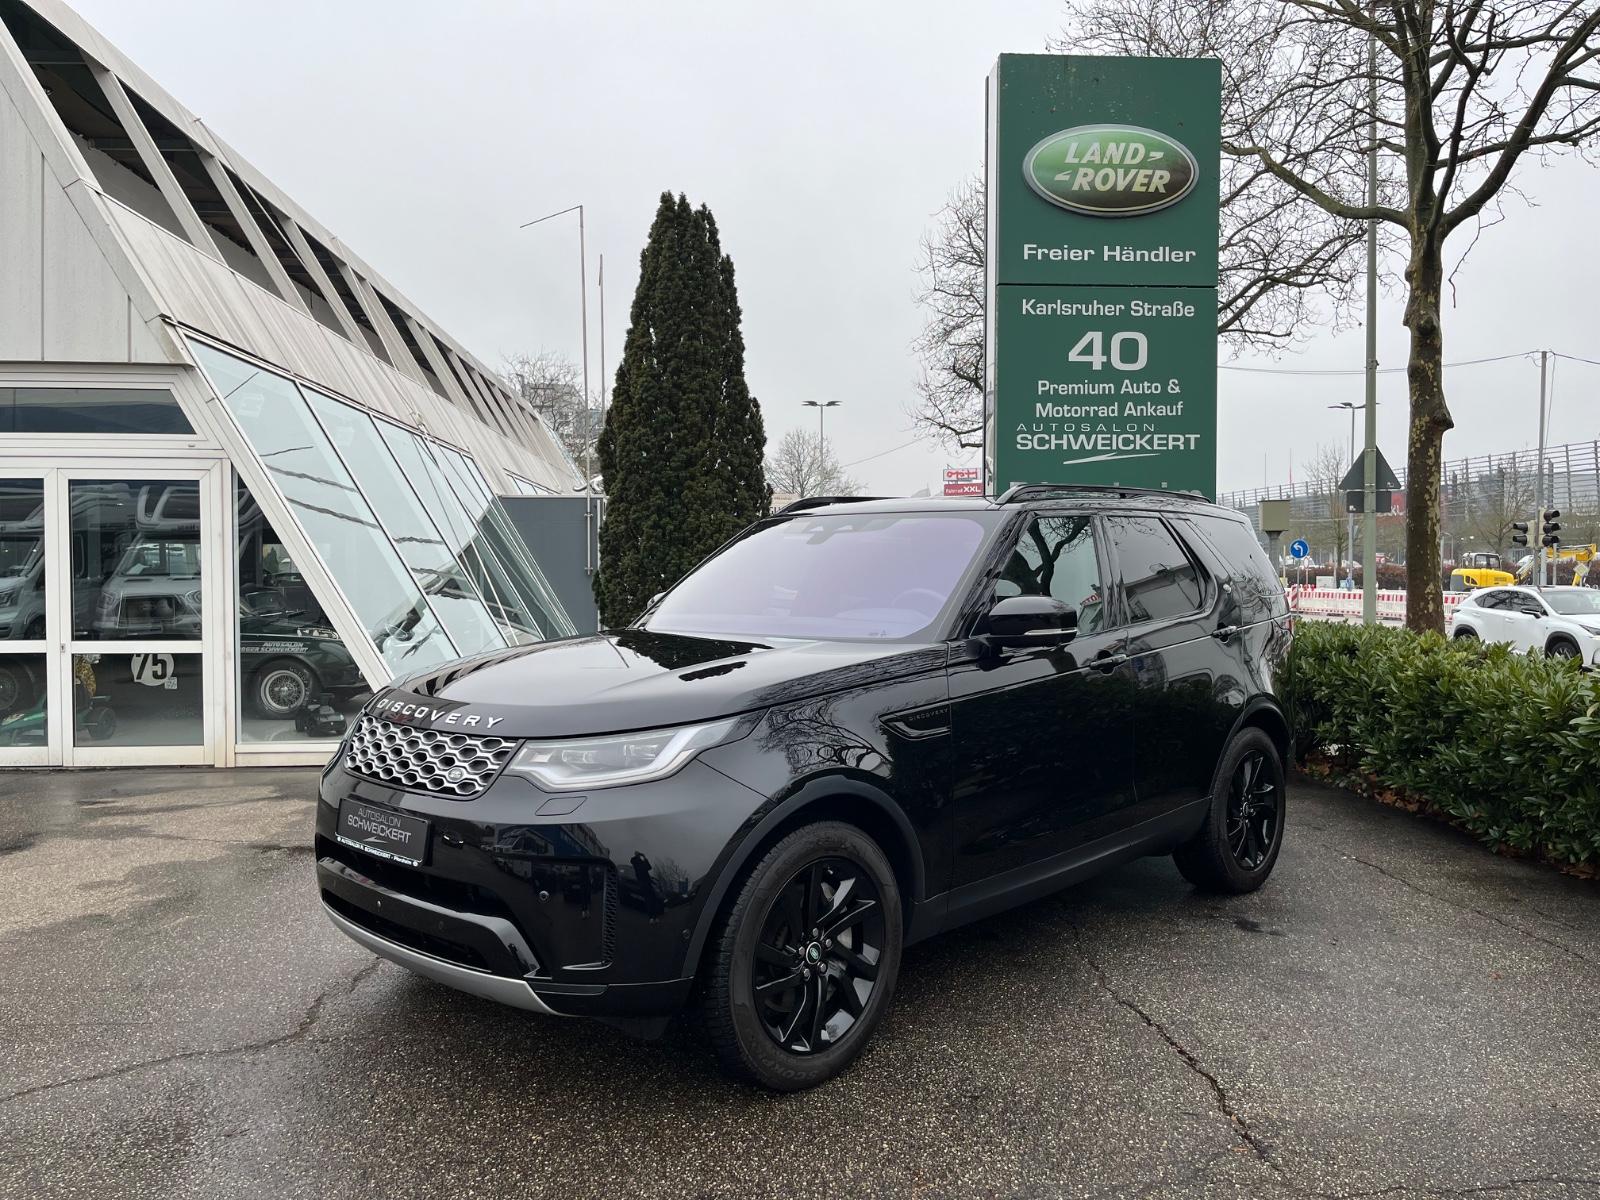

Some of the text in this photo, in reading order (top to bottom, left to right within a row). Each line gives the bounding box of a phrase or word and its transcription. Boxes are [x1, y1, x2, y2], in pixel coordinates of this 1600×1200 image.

[1064, 142, 1146, 165] LAND
[1071, 168, 1171, 193] ROVER
[1023, 244, 1197, 262] Freier Händler
[1022, 299, 1195, 317] Karlsruher Straße
[1068, 331, 1148, 371] 40
[1037, 379, 1181, 395] Premium Auto &
[1035, 401, 1184, 418] Motorrad Ankauf
[1016, 423, 1155, 432] AUTOSALON
[1016, 434, 1201, 450] SCHWEICKERT
[135, 653, 168, 680] 75
[376, 698, 504, 729] DISCOVERY
[358, 808, 401, 827] AUTOSALON
[347, 814, 412, 844] SCHWEICKERT
